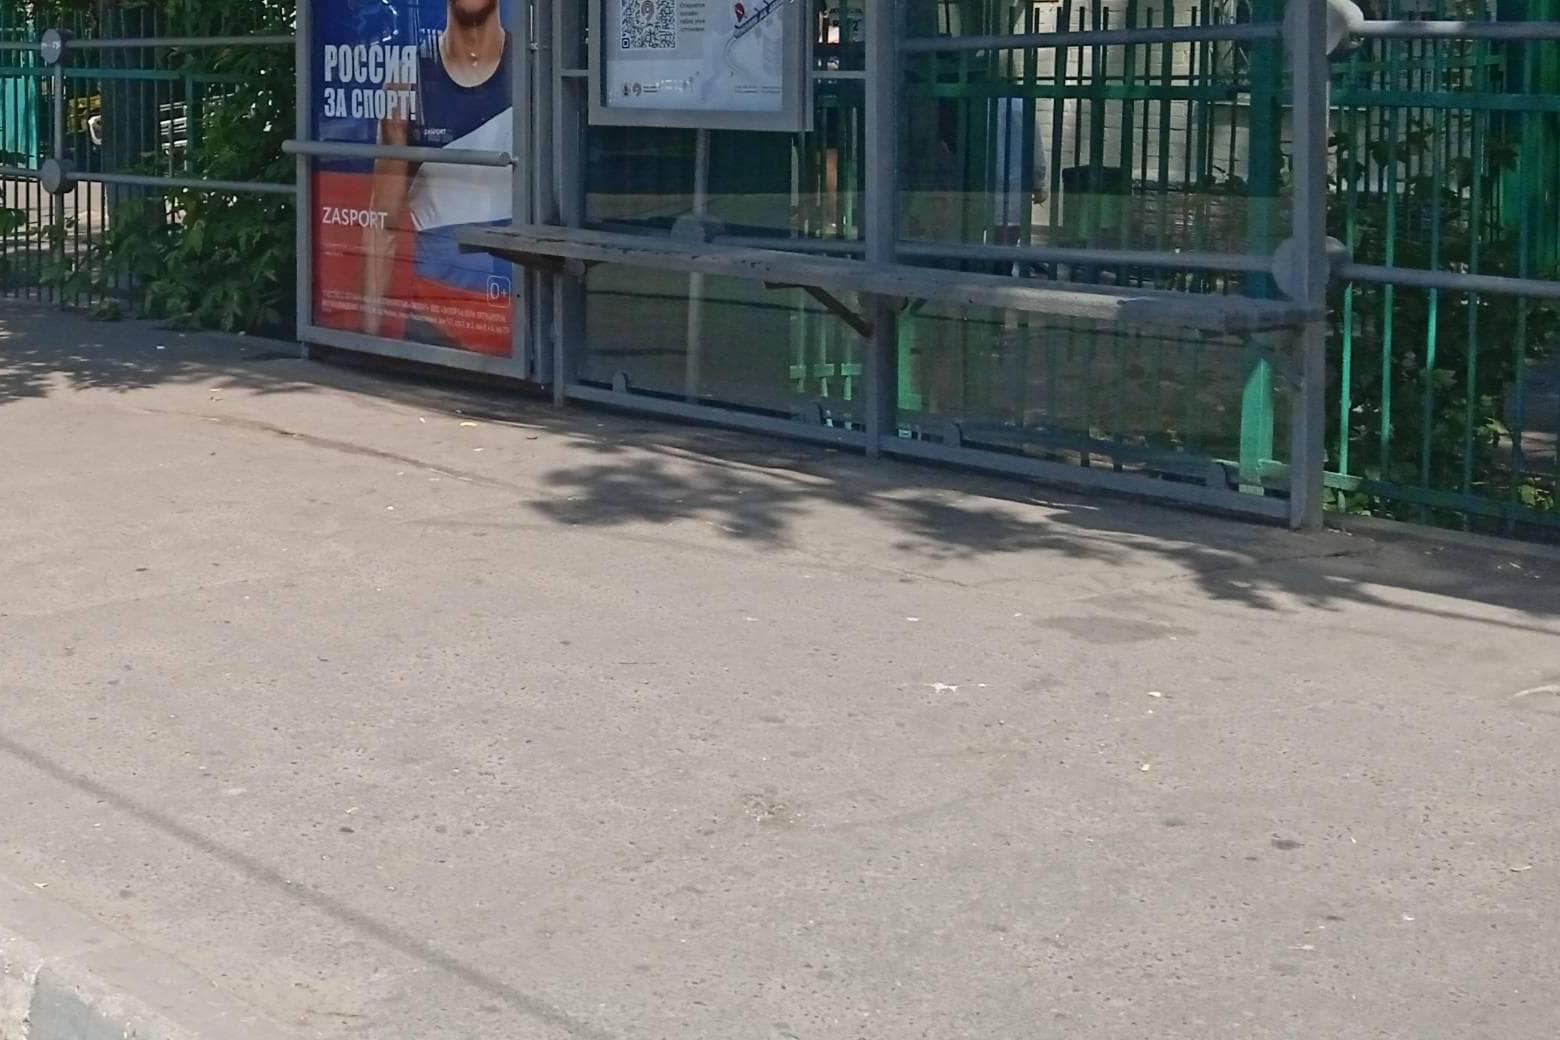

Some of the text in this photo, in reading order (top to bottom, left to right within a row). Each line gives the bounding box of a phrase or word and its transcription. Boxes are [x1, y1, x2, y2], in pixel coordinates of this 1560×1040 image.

[324, 44, 417, 84] РОССИЯ
[324, 87, 416, 120] ЗА СПОРТ!
[322, 207, 388, 230] ZASPORT
